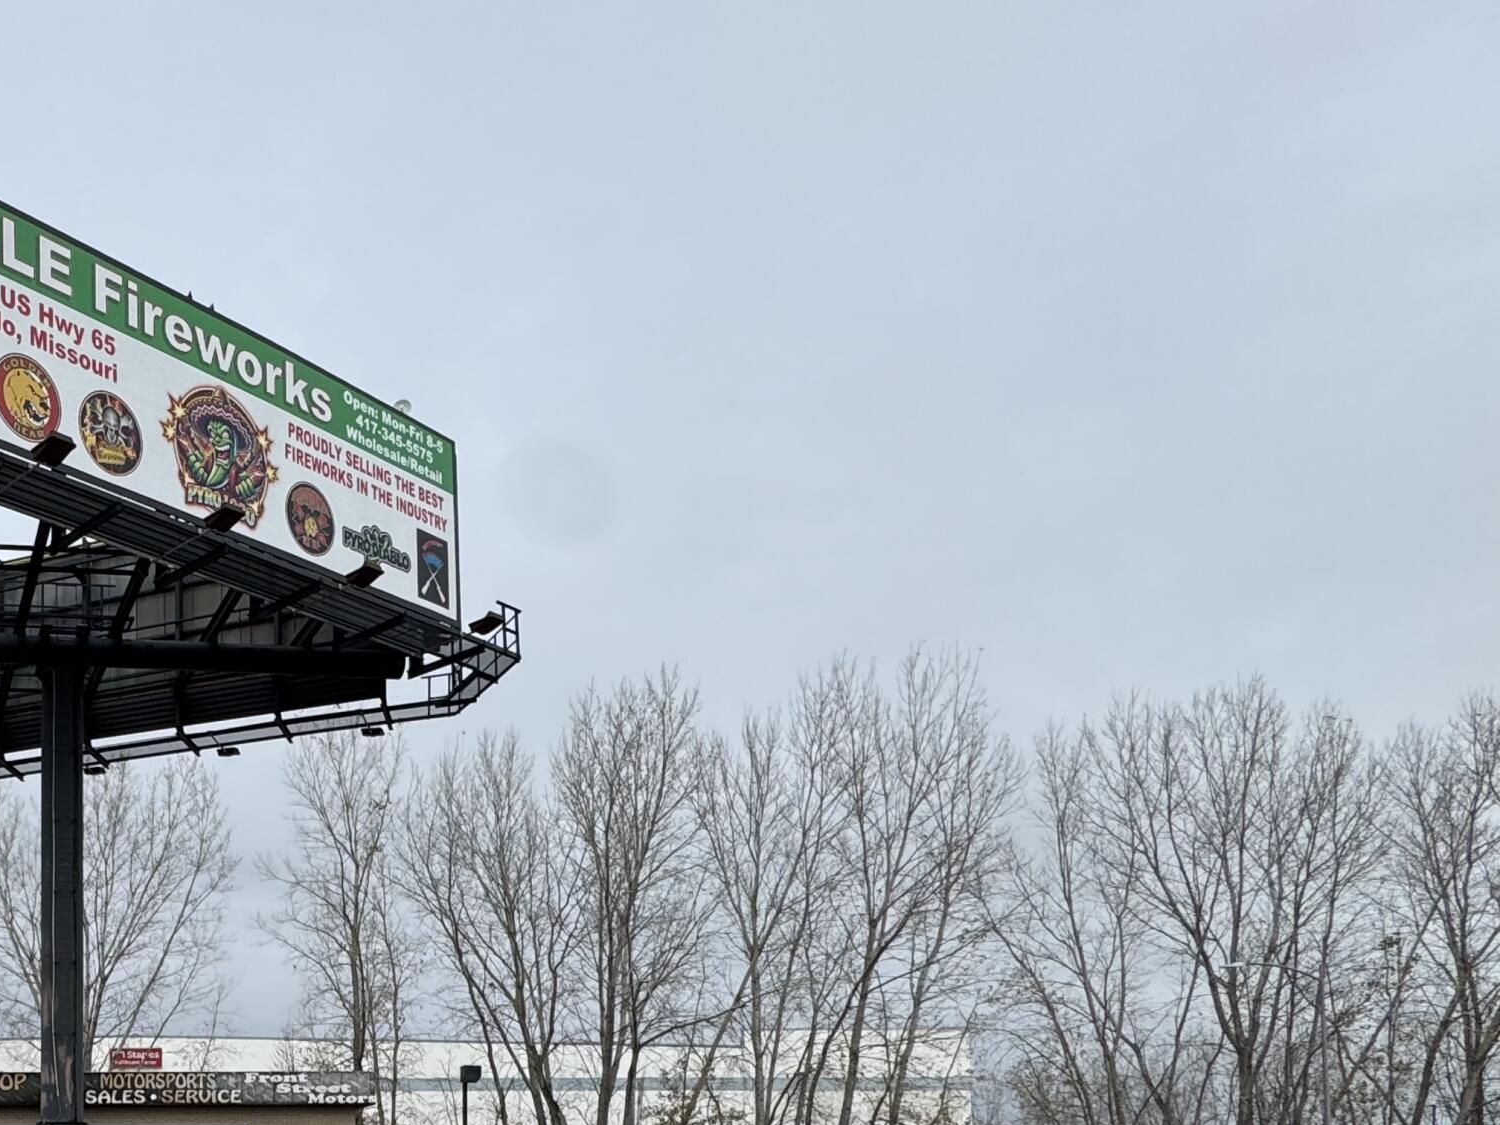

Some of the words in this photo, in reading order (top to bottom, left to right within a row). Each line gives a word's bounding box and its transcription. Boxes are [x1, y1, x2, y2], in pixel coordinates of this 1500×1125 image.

[0, 284, 31, 317] US
[38, 302, 85, 346] Hwy
[91, 328, 117, 356] 65
[94, 263, 333, 423] Fireworks
[3, 359, 52, 388] GOLDEN
[29, 325, 119, 384] Missouri
[343, 390, 379, 420] Open:
[381, 410, 424, 444] Mon-Fri
[426, 435, 444, 454] 8-5
[355, 414, 434, 464] 417-345-5575
[287, 422, 343, 462] PROUDLY
[345, 450, 392, 486] SELLING
[394, 474, 416, 498] THE
[418, 485, 445, 512] BEST
[346, 424, 444, 485] Wholesale/Retail
[284, 443, 353, 489] FIREWORKS
[356, 477, 369, 497] IN
[371, 484, 393, 508] THE
[395, 496, 448, 533] INDUSTRY
[126, 1050, 160, 1059] Stapes
[244, 1072, 308, 1084] Front
[84, 1089, 146, 1104] SALES
[161, 1089, 242, 1104] SERVICE
[100, 1073, 217, 1089] MOTORSPORTS
[275, 1083, 352, 1094] Street
[307, 1093, 376, 1105] Motors
